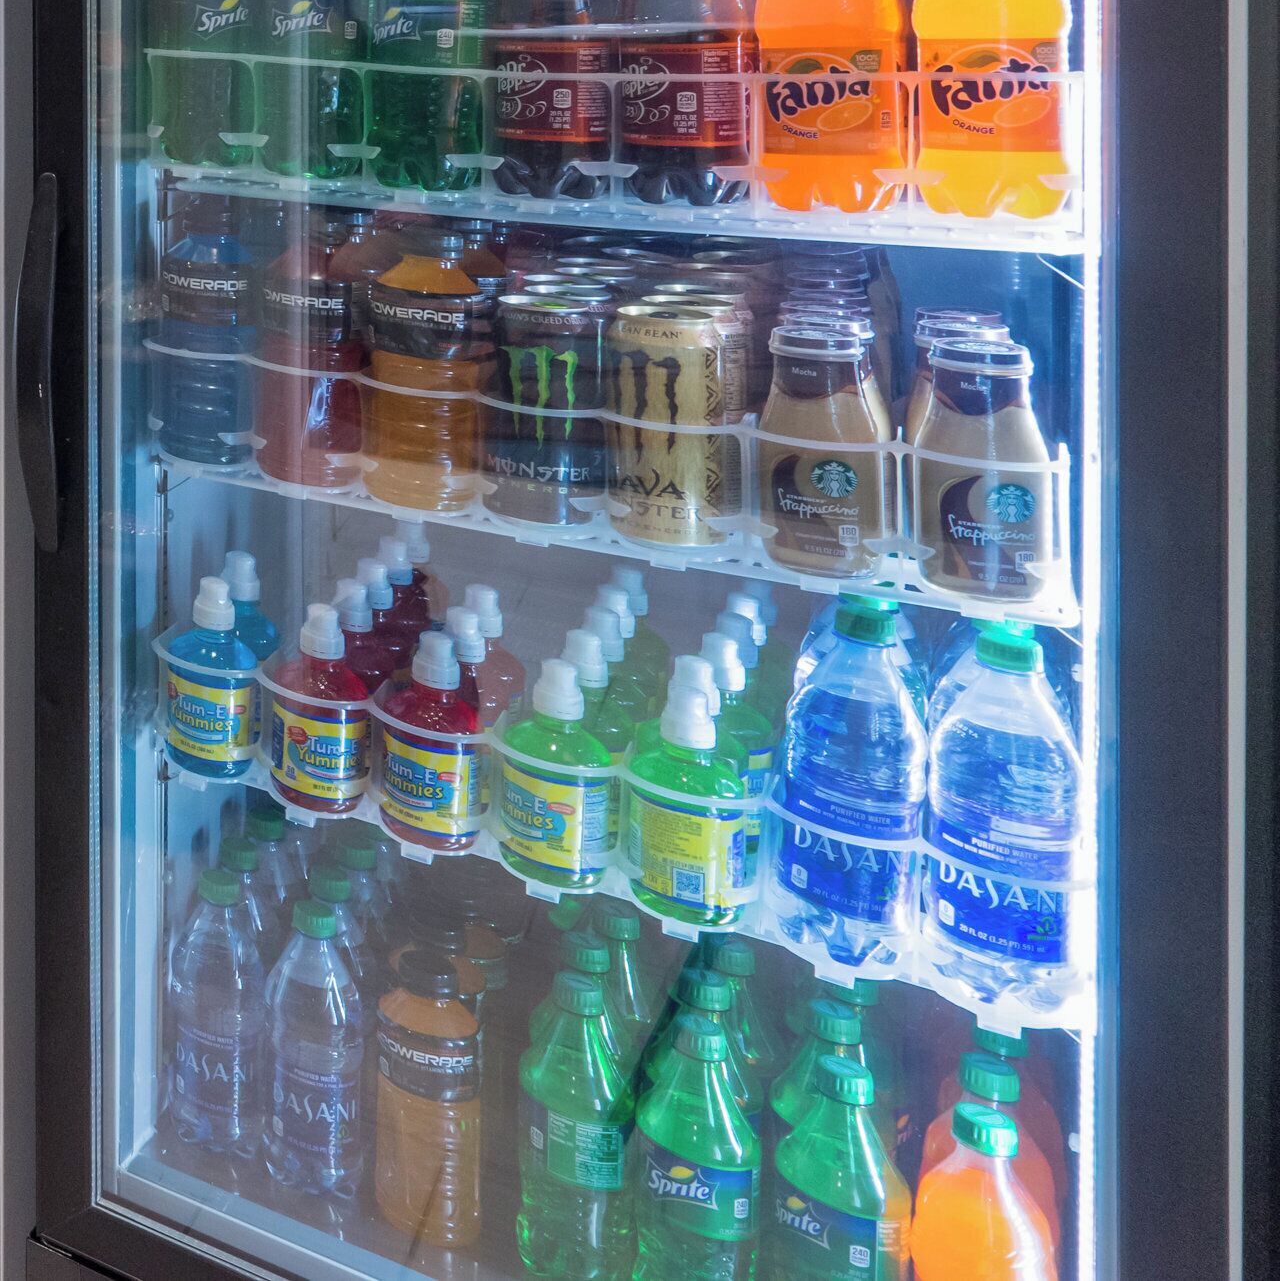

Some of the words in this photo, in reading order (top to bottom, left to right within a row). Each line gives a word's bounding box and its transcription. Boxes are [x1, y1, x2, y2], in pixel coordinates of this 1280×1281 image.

[198, 6, 248, 32] Sprite
[272, 11, 324, 37] Sprite
[438, 30, 452, 39] 240
[555, 90, 569, 99] 250
[679, 93, 694, 102] 250
[766, 66, 870, 122] Fanta
[931, 59, 1049, 116] Fanta
[782, 125, 819, 139] ORANGE
[953, 119, 995, 134] ORANGE
[264, 288, 345, 309] OWERADE
[531, 316, 562, 325] CREED
[645, 330, 679, 339] BEAN
[792, 367, 817, 377] Mocha
[488, 454, 589, 483] MONSTER
[618, 468, 685, 500] AVA
[841, 527, 857, 536] 180
[1018, 553, 1034, 562] 180
[177, 693, 226, 719] Tum-E
[172, 704, 232, 732] Yummies
[308, 736, 359, 754] Tum-E
[387, 752, 437, 785] Tum-E
[830, 805, 866, 819] PURIFIED
[868, 815, 890, 824] WATER
[795, 824, 903, 874] DASAN
[972, 837, 1010, 855] PURIFIED
[1012, 849, 1038, 860] WATER
[960, 923, 968, 932] 20
[969, 927, 977, 936] FL
[978, 931, 987, 940] OZ
[989, 936, 1007, 946] (1.25
[1008, 940, 1020, 950] PT)
[1022, 943, 1034, 951] 591
[648, 1169, 709, 1200] Sprite
[736, 1200, 748, 1208] 240
[852, 1247, 868, 1258] 240
